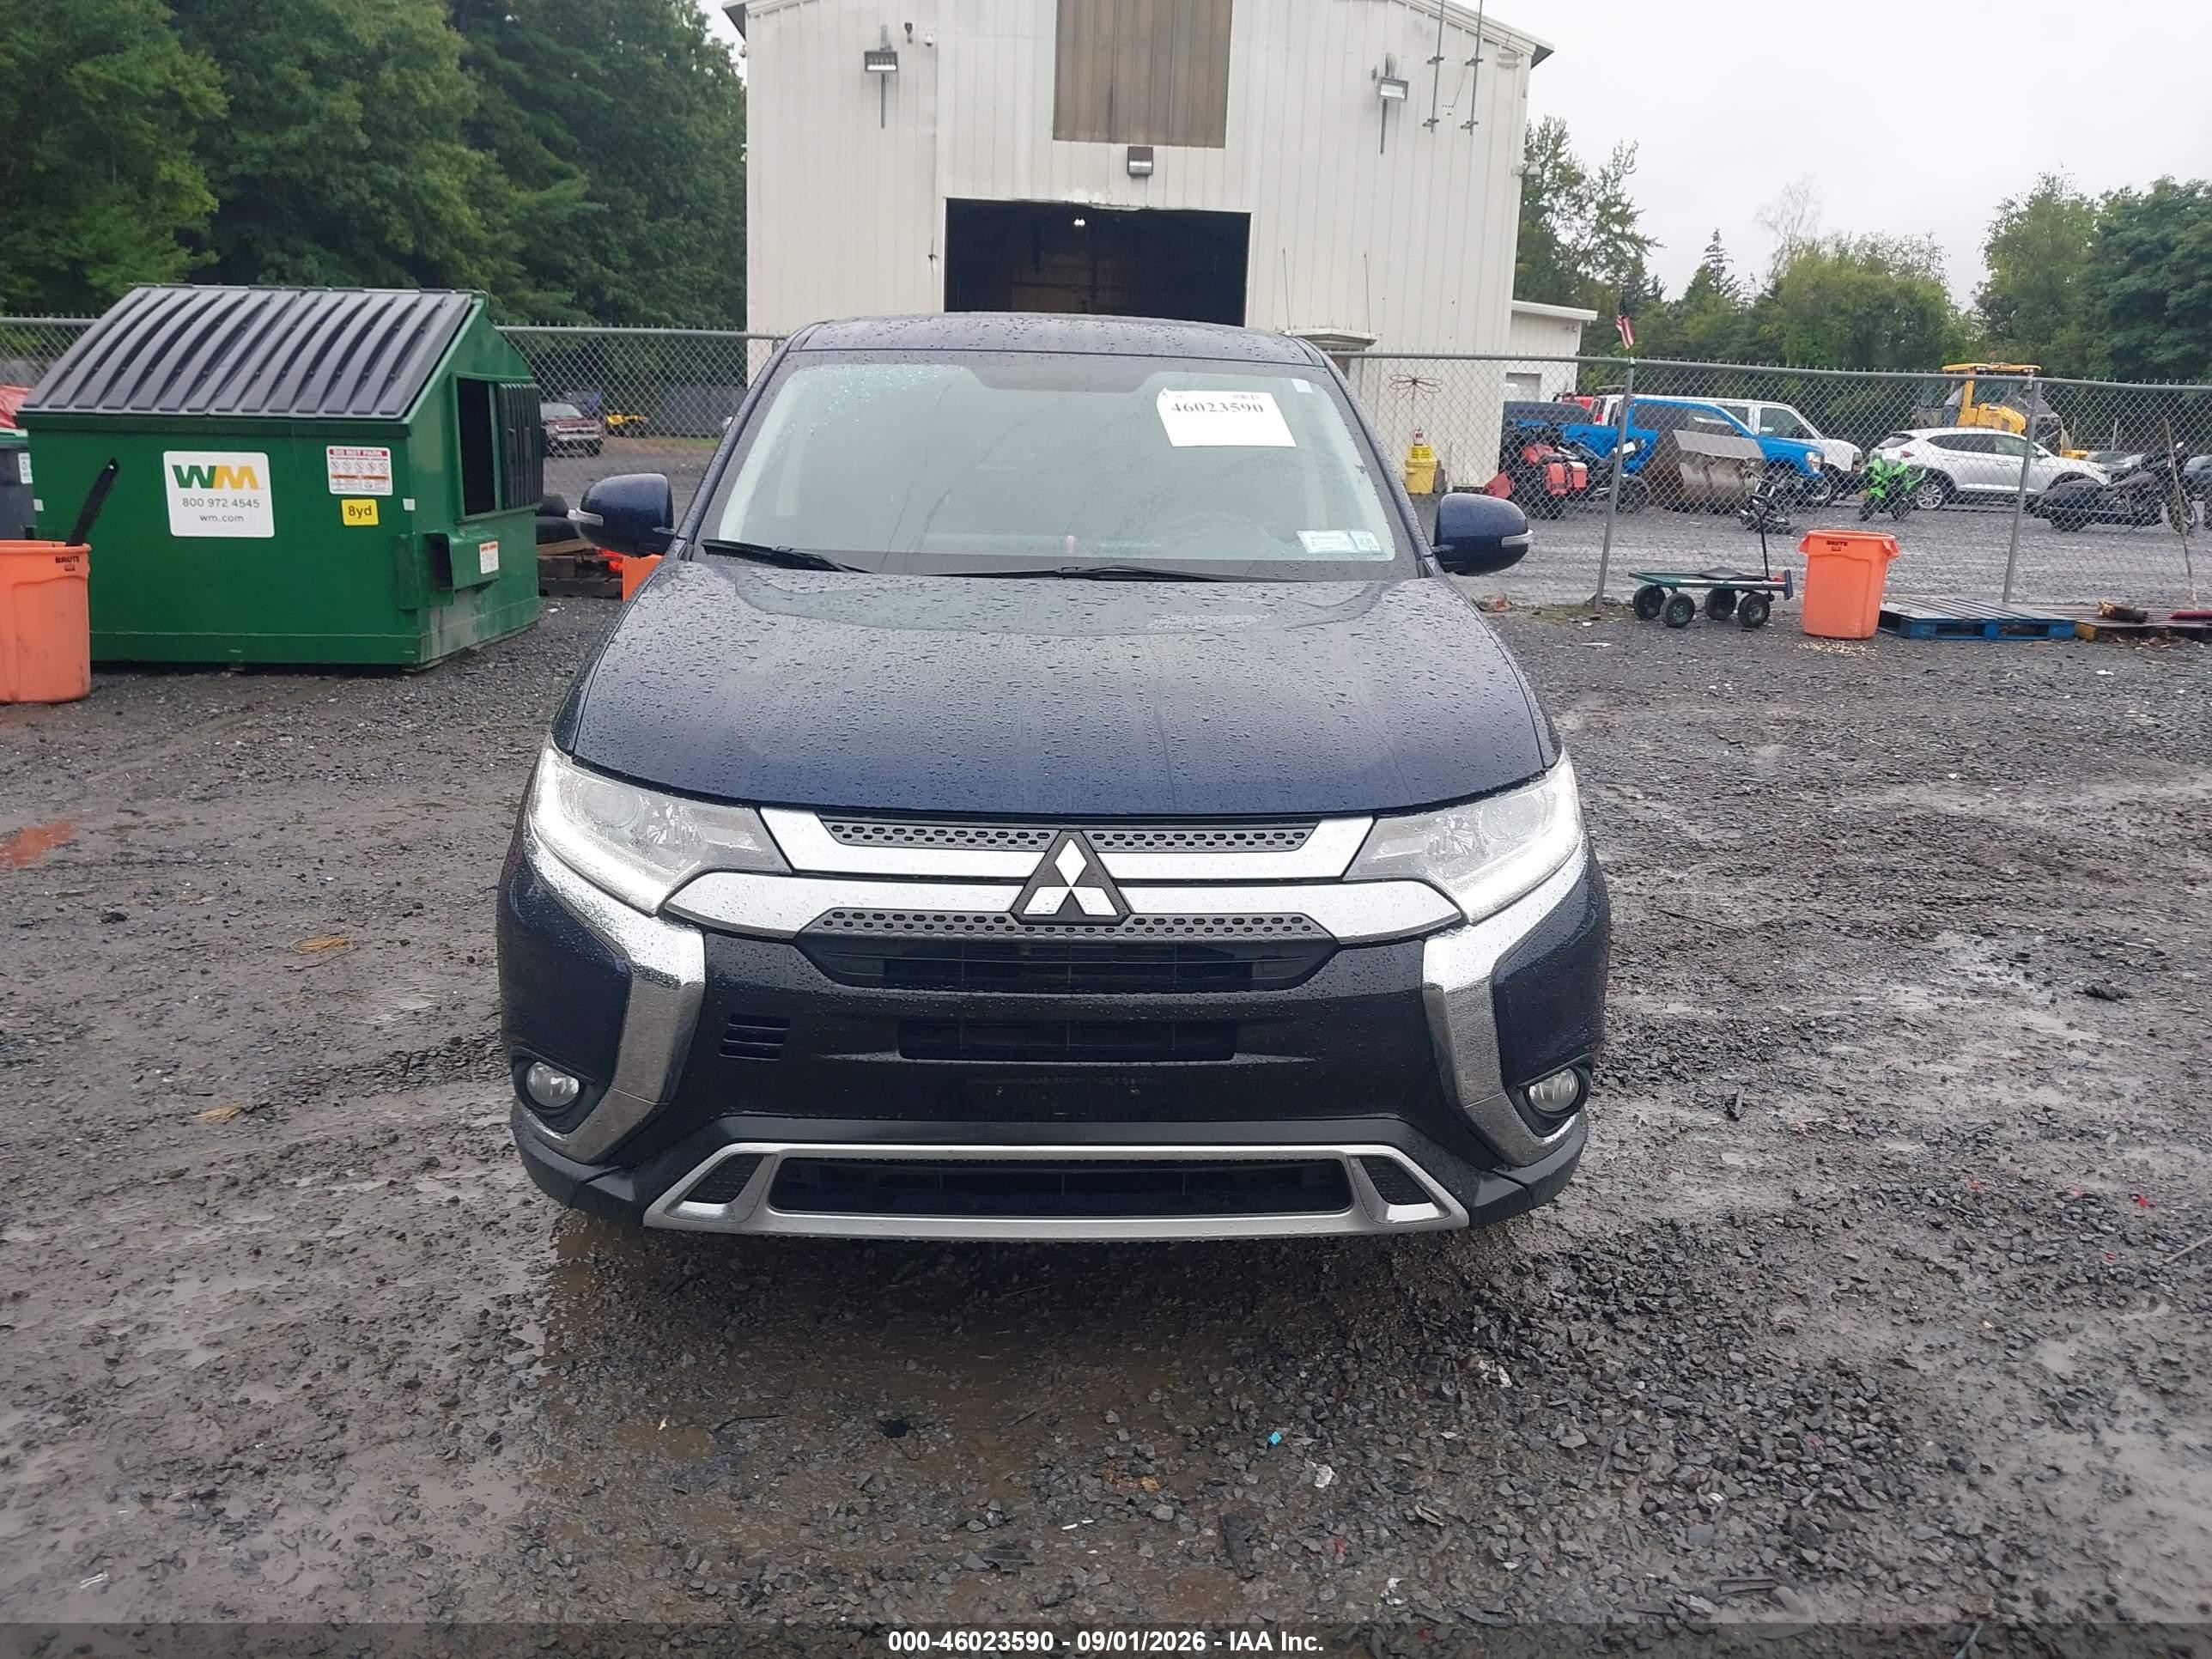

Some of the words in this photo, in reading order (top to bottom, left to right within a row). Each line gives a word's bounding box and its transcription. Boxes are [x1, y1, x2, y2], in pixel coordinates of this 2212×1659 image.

[1170, 402, 1264, 413] 46023590
[172, 465, 260, 489] WM
[182, 497, 204, 507] 800
[207, 498, 228, 508] 972
[232, 499, 260, 508] 4545
[348, 505, 373, 520] 8yd
[199, 514, 245, 523] wm.com
